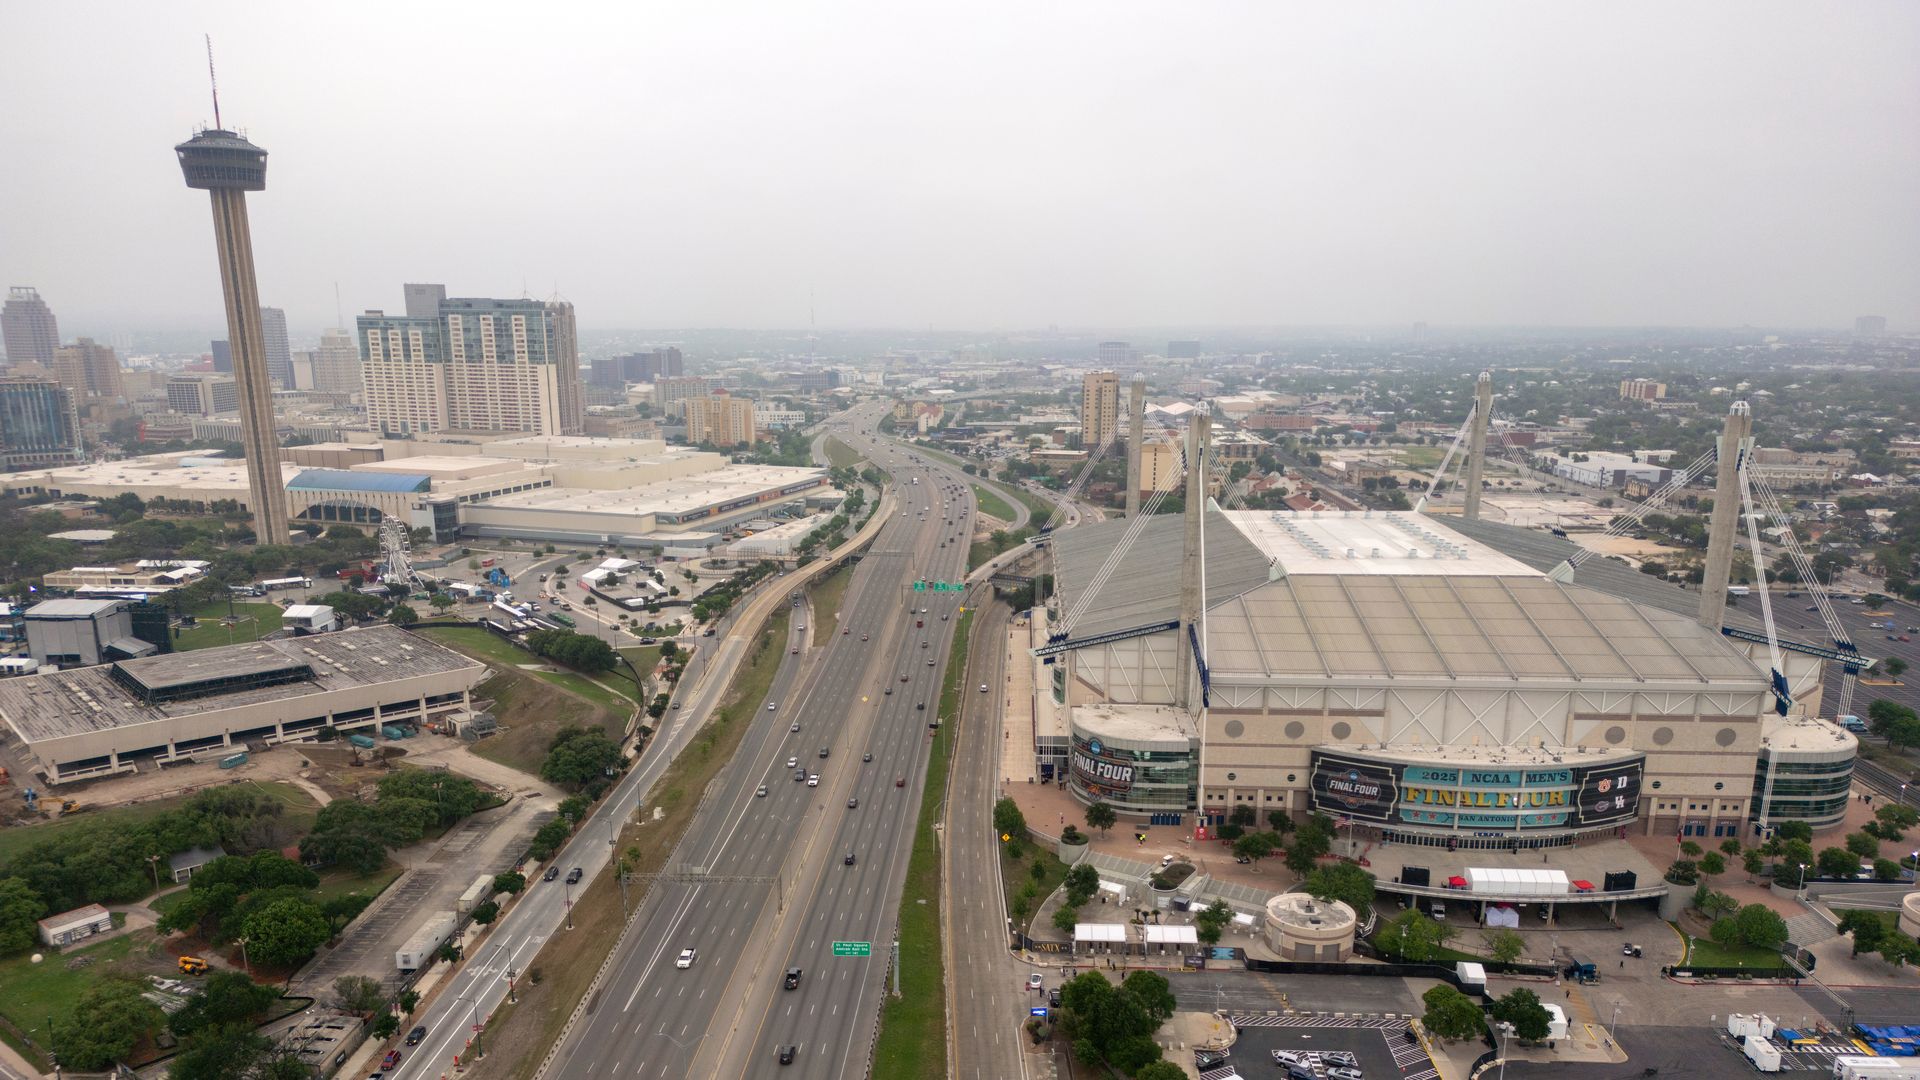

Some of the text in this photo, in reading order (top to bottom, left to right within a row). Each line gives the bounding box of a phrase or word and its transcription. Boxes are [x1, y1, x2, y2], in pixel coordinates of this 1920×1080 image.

[1074, 752, 1132, 781] FINAL FOUR
[1422, 771, 1568, 784] 2025 NCAA MEN'S
[1330, 780, 1378, 795] FINAL FOUR
[1405, 787, 1492, 807] FINAL
[1040, 943, 1060, 952] SATX
